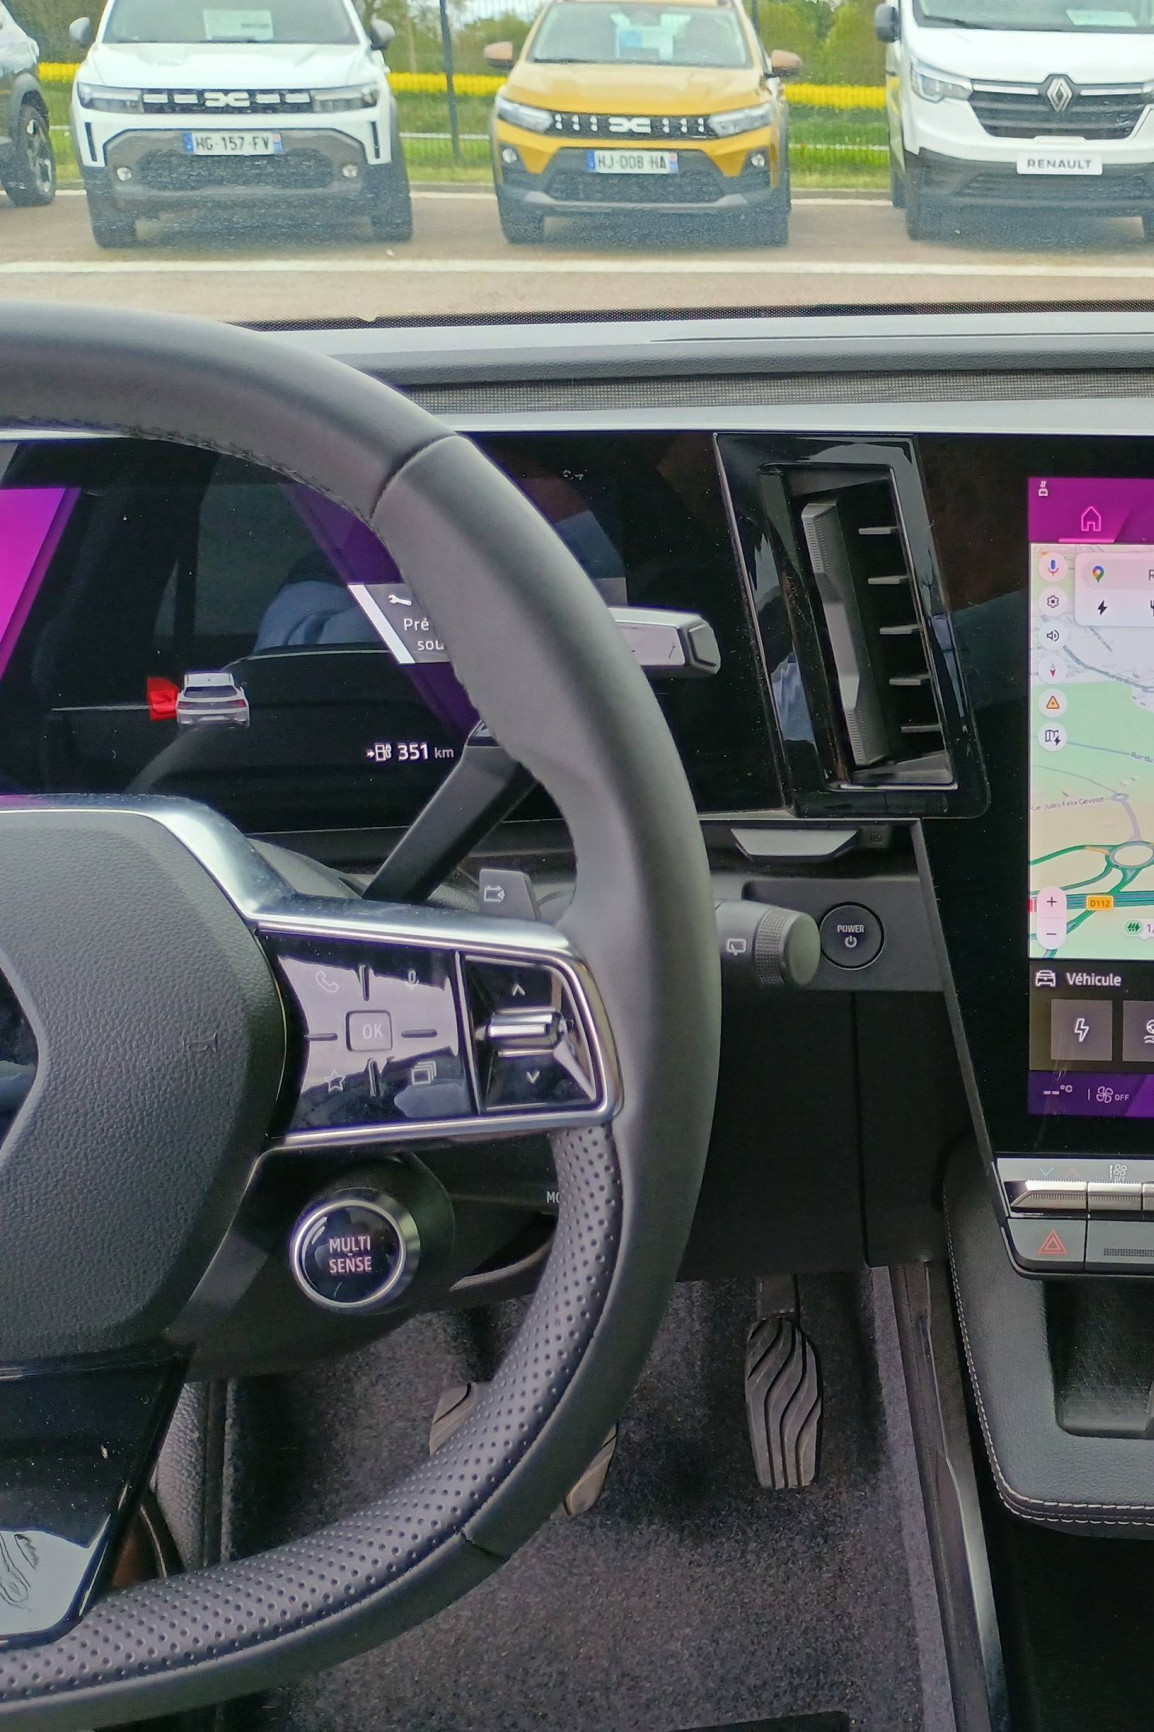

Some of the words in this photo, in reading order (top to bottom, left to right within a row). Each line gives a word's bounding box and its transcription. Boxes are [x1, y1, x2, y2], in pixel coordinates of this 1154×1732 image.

[1027, 159, 1092, 170] RENAULT
[397, 742, 429, 761] 351
[434, 747, 454, 759] km
[1131, 751, 1144, 760] Rue
[1089, 897, 1111, 909] D112
[837, 924, 865, 934] POWER
[1066, 971, 1122, 987] Véhicule
[362, 1023, 384, 1040] OK
[1114, 1093, 1130, 1102] OFF
[328, 1235, 371, 1251] MULTI
[328, 1257, 373, 1275] SENSE
